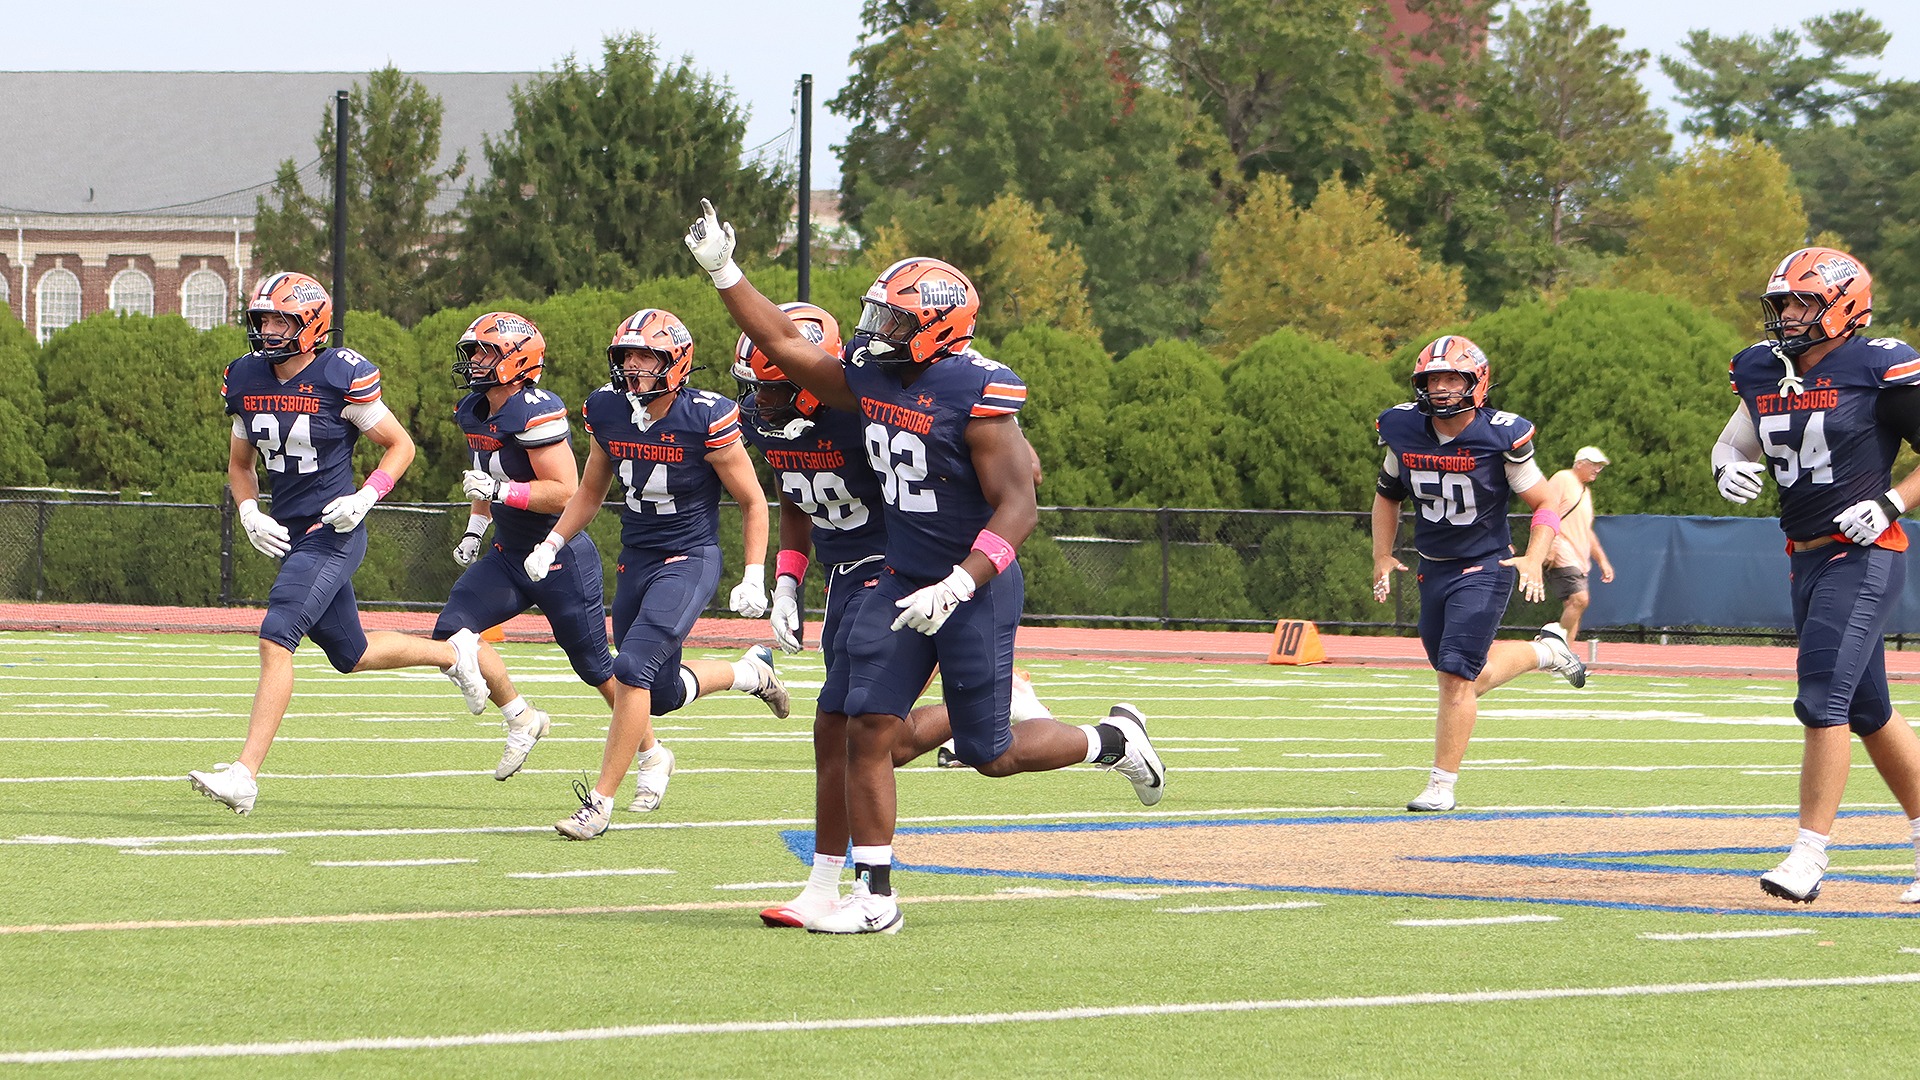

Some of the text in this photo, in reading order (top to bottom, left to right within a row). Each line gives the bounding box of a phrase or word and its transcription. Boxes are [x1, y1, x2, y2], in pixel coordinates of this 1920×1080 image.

[920, 280, 967, 307] Bullets
[243, 395, 320, 413] GETTYSBURG
[860, 396, 934, 435] GETTYSBURG
[1756, 389, 1839, 414] GETTYSBURG
[251, 413, 319, 473] 24
[608, 441, 684, 462] GETTYSBURG
[766, 449, 845, 469] GETTYSBURG
[1759, 411, 1834, 488] 54
[864, 421, 939, 513] 92
[1402, 452, 1477, 472] GETTYSBURG
[618, 459, 677, 515] 14
[781, 471, 870, 531] 28
[1410, 469, 1478, 526] 50
[1277, 622, 1304, 656] 10
